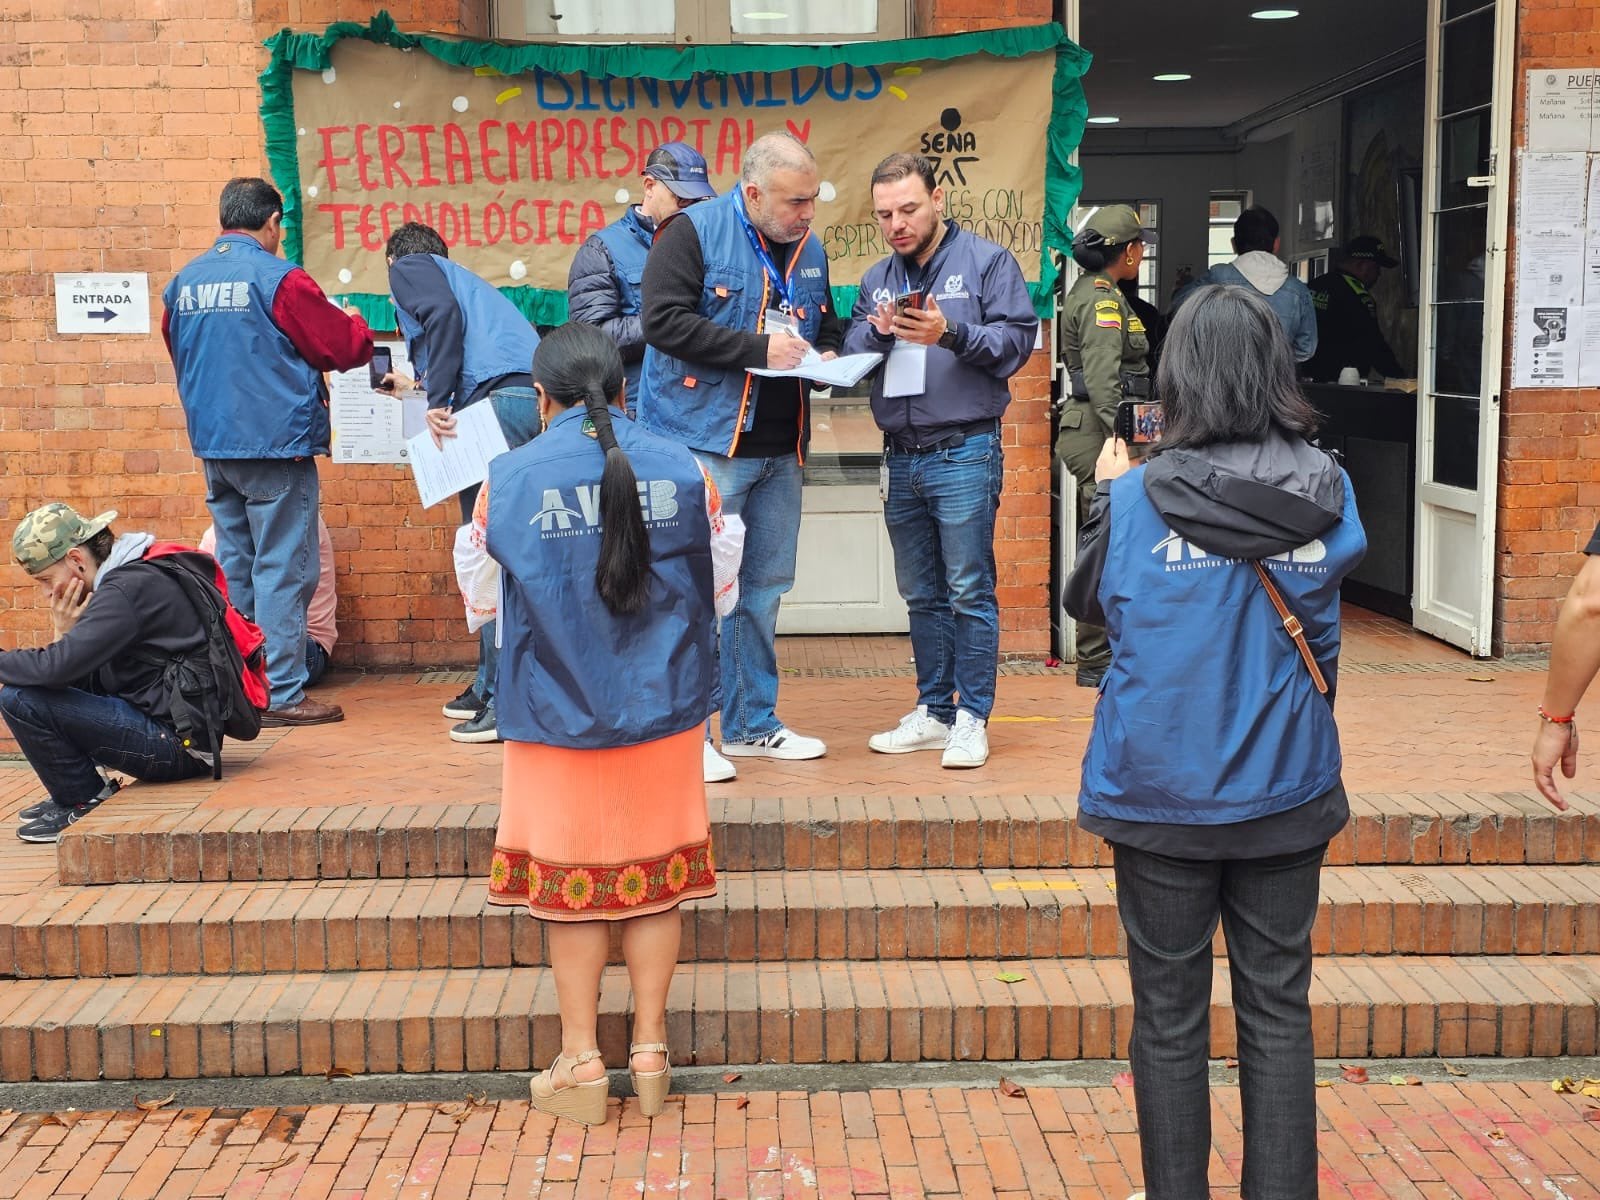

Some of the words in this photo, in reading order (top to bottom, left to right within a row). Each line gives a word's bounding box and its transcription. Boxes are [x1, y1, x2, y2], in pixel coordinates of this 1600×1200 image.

[920, 131, 976, 154] SENA
[317, 122, 473, 192] FERIA
[983, 189, 1023, 220] CON
[73, 294, 132, 304] ENTRADA
